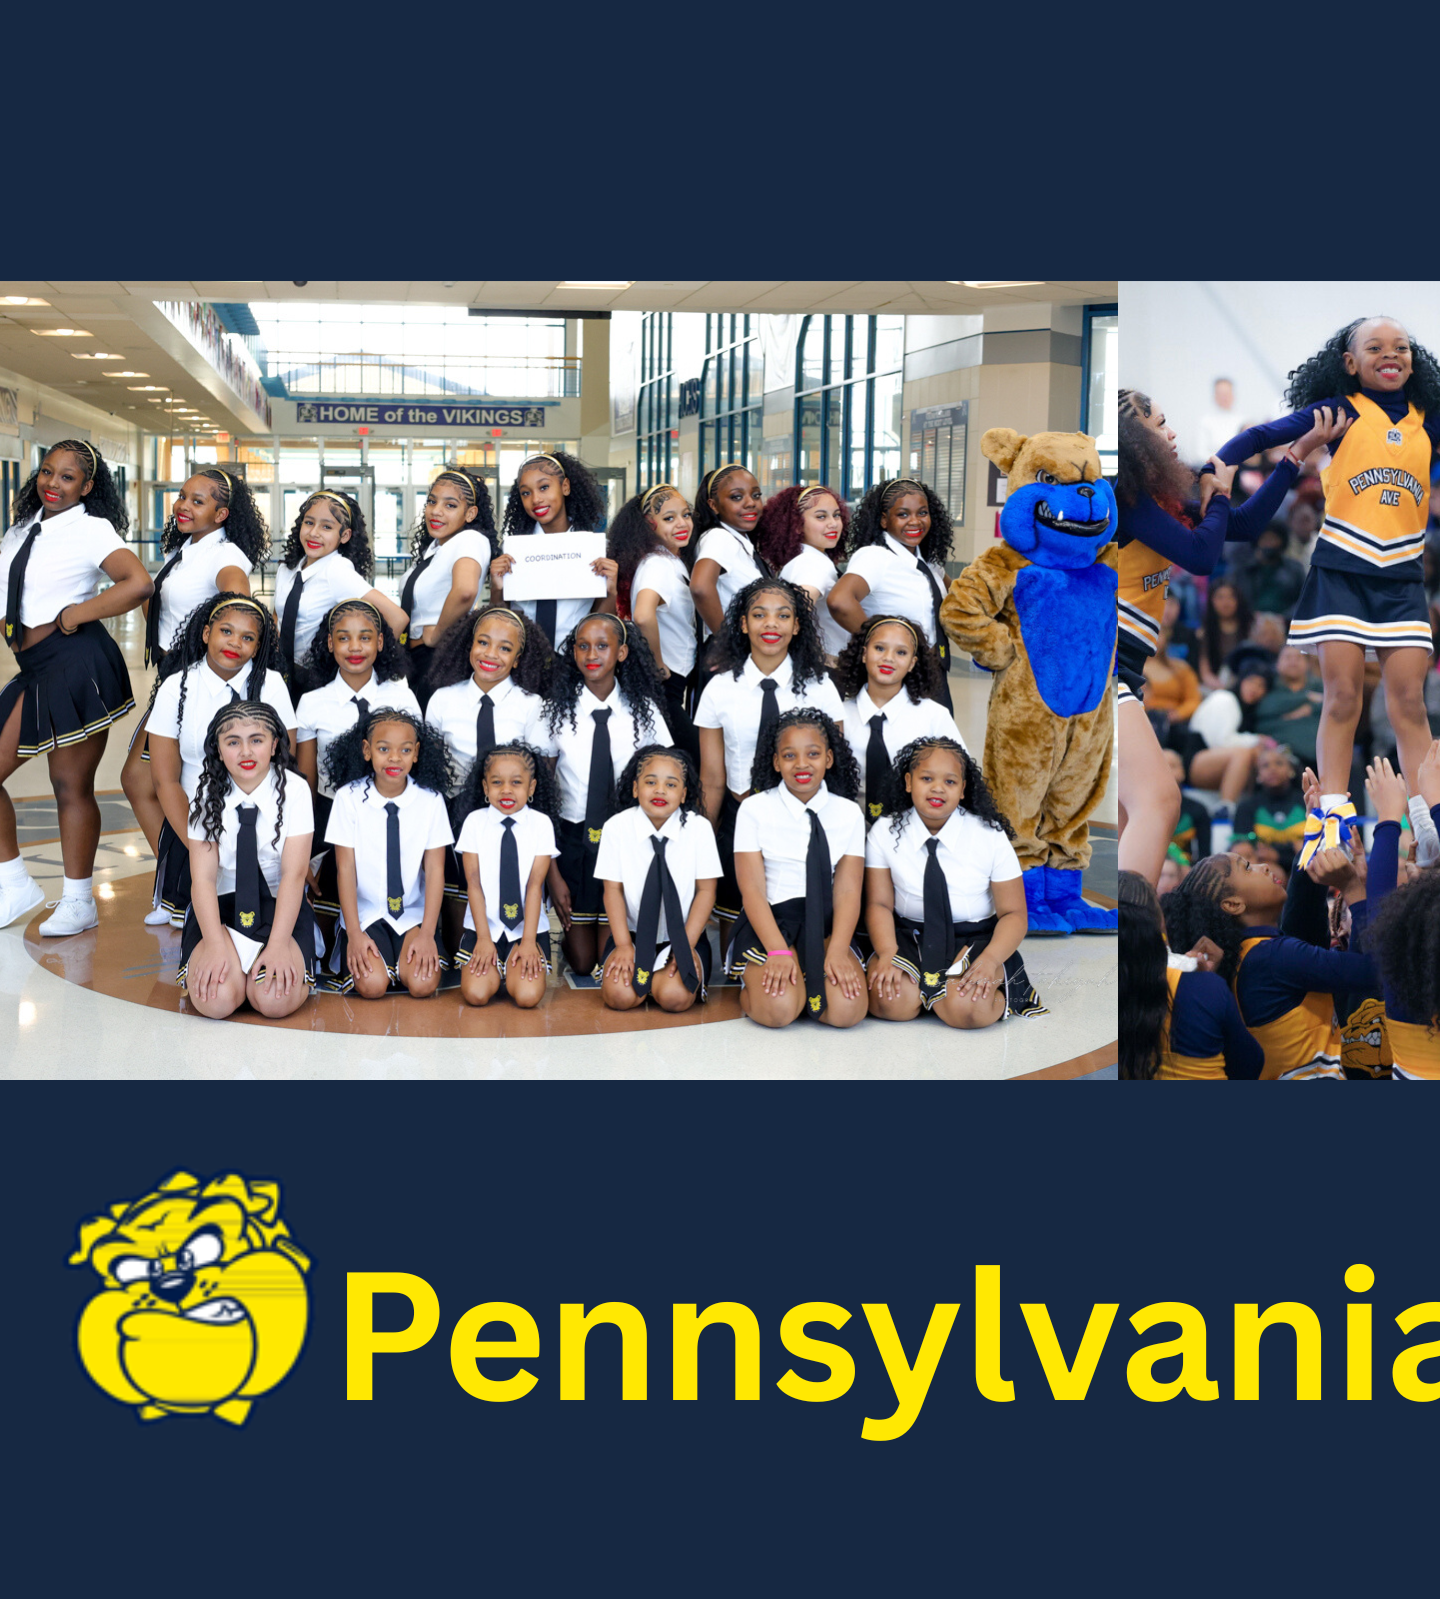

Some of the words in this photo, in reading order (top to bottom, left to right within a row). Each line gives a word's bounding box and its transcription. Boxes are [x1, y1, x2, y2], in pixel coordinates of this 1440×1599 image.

[319, 406, 379, 422] HOME
[384, 408, 402, 423] of
[408, 408, 438, 424] the
[442, 408, 523, 425] VIKINGS
[1348, 467, 1424, 507] PENNSYLVANIA
[1379, 489, 1401, 506] AVE
[524, 552, 582, 563] COORDINATION
